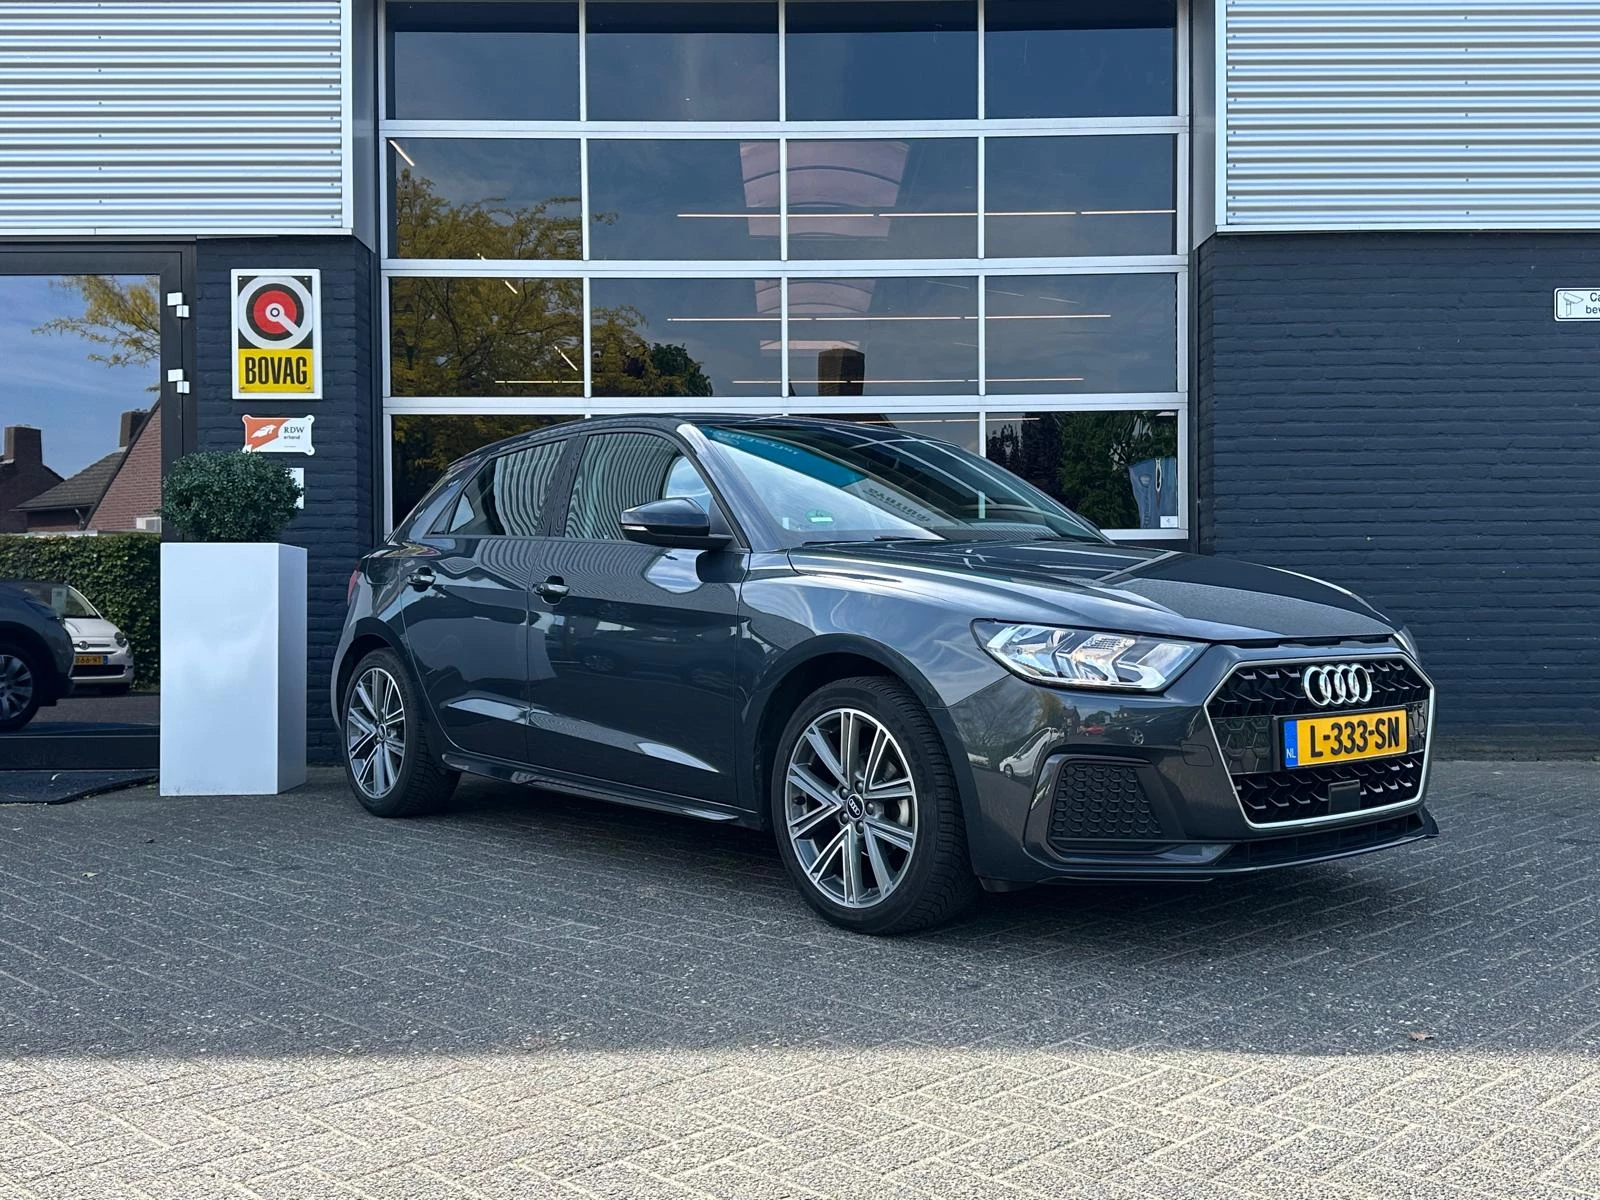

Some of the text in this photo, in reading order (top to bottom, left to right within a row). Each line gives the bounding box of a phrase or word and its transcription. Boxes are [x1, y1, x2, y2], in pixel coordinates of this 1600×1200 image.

[245, 356, 308, 385] BOVAG
[283, 426, 305, 434] RDW
[1310, 716, 1400, 758] L-333-SN
[1286, 747, 1297, 759] NL
